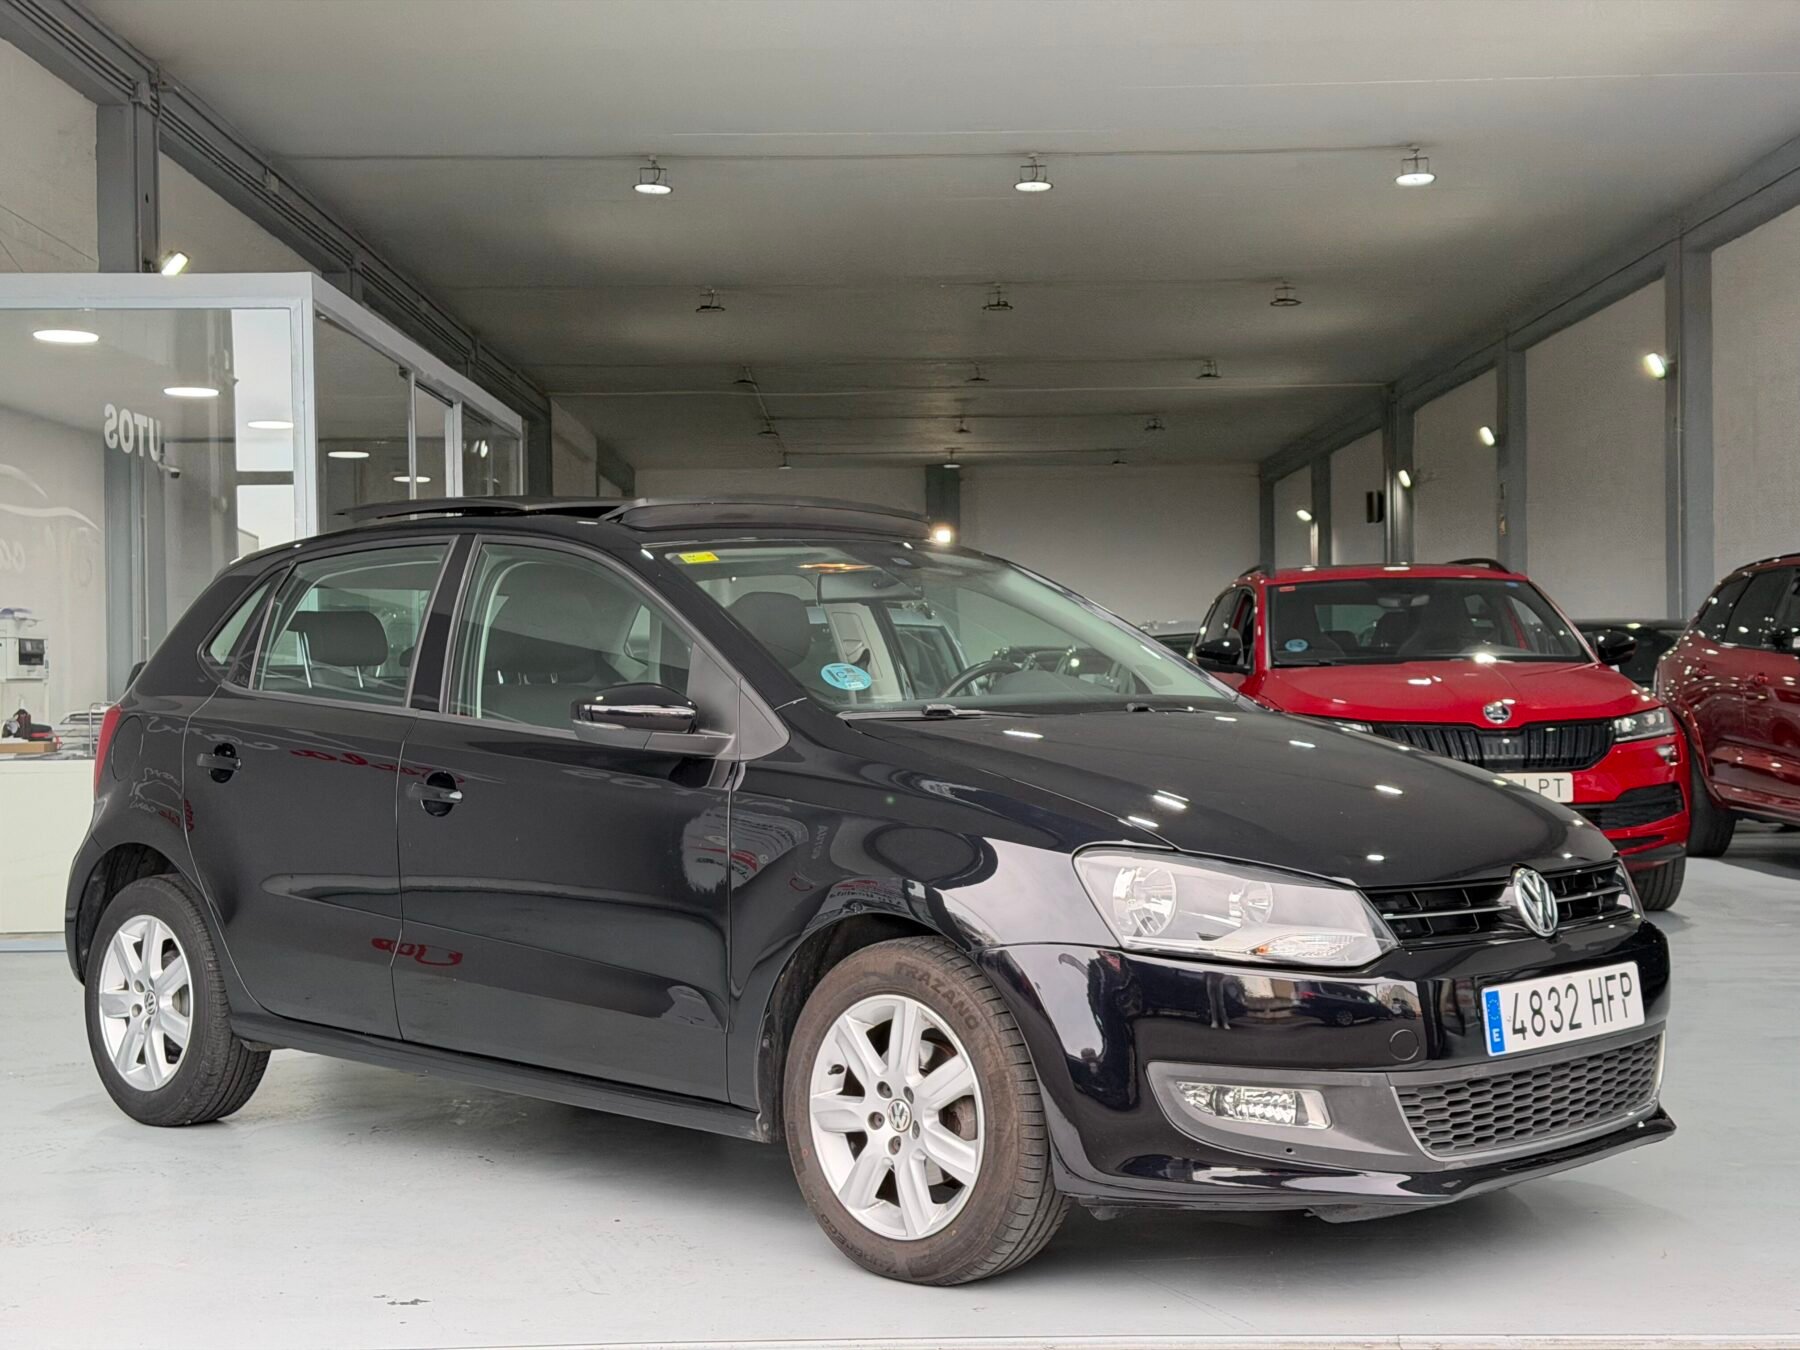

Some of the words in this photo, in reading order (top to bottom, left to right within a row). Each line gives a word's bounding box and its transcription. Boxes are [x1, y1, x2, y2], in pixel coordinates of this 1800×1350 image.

[895, 961, 979, 1030] TRAZANO
[1512, 982, 1583, 1041] 4832
[1588, 971, 1633, 1026] HFP
[1492, 1028, 1501, 1043] E
